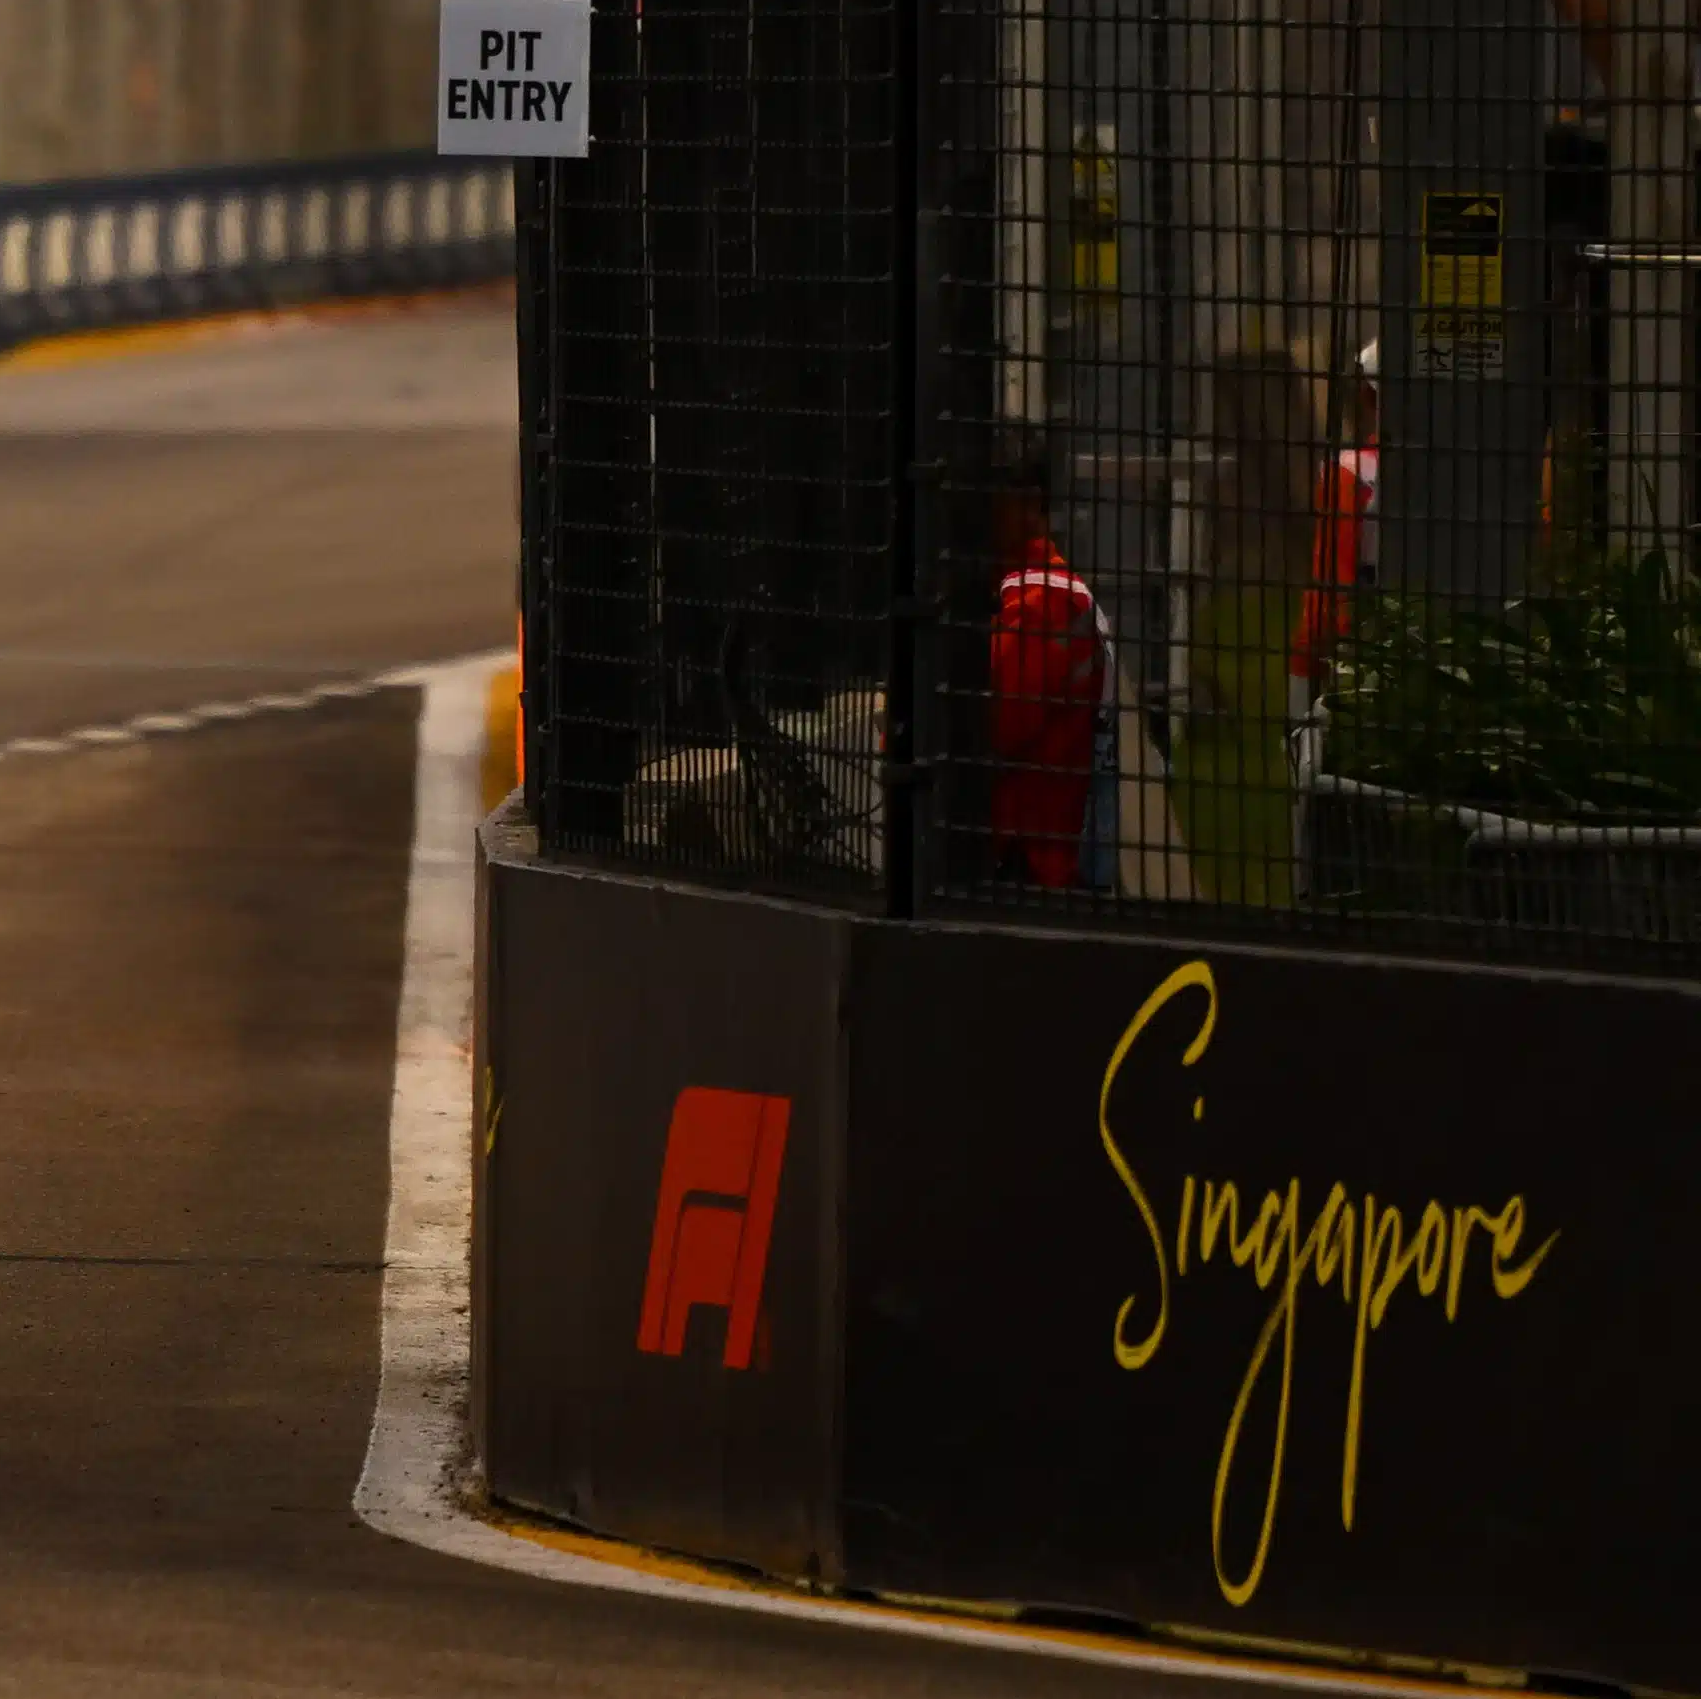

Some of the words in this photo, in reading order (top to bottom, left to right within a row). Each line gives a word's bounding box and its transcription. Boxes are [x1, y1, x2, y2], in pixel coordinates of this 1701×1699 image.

[479, 30, 542, 71] PIT
[447, 79, 572, 122] ENTRY
[1099, 960, 1560, 1605] Singapore
